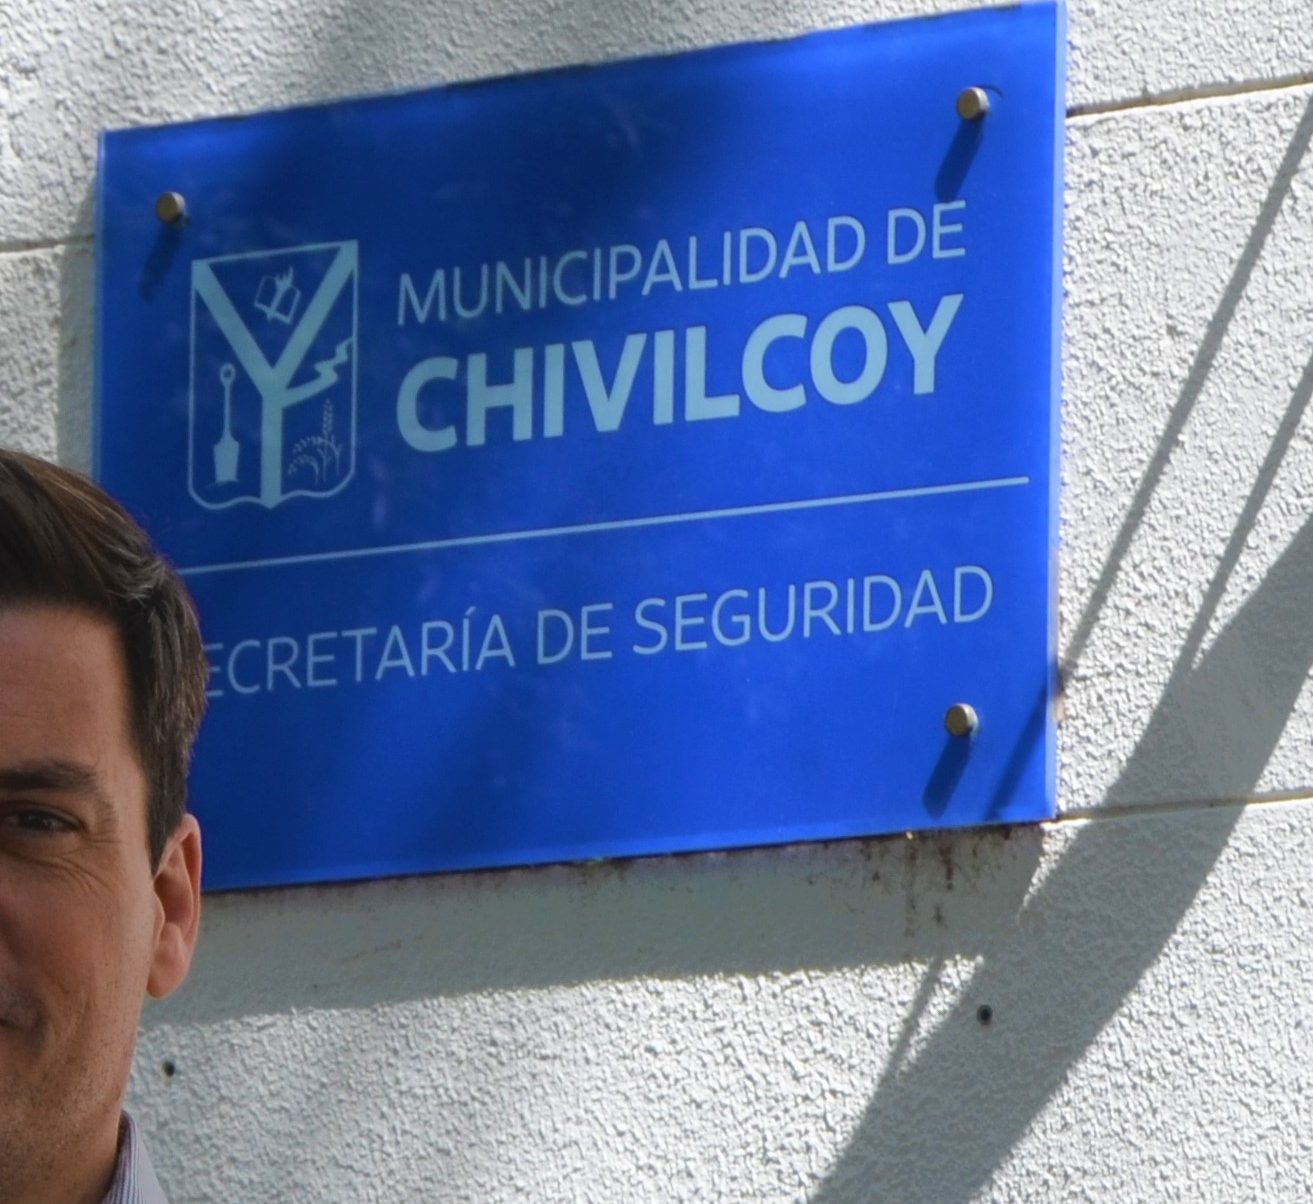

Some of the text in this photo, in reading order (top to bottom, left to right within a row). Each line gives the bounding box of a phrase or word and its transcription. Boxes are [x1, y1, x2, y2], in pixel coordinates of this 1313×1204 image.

[397, 201, 967, 326] MUNICIPALIDAD DE
[396, 294, 965, 453] CHIVILCOY
[204, 565, 995, 698] ECRETARÍA DE SEGURIDAD
